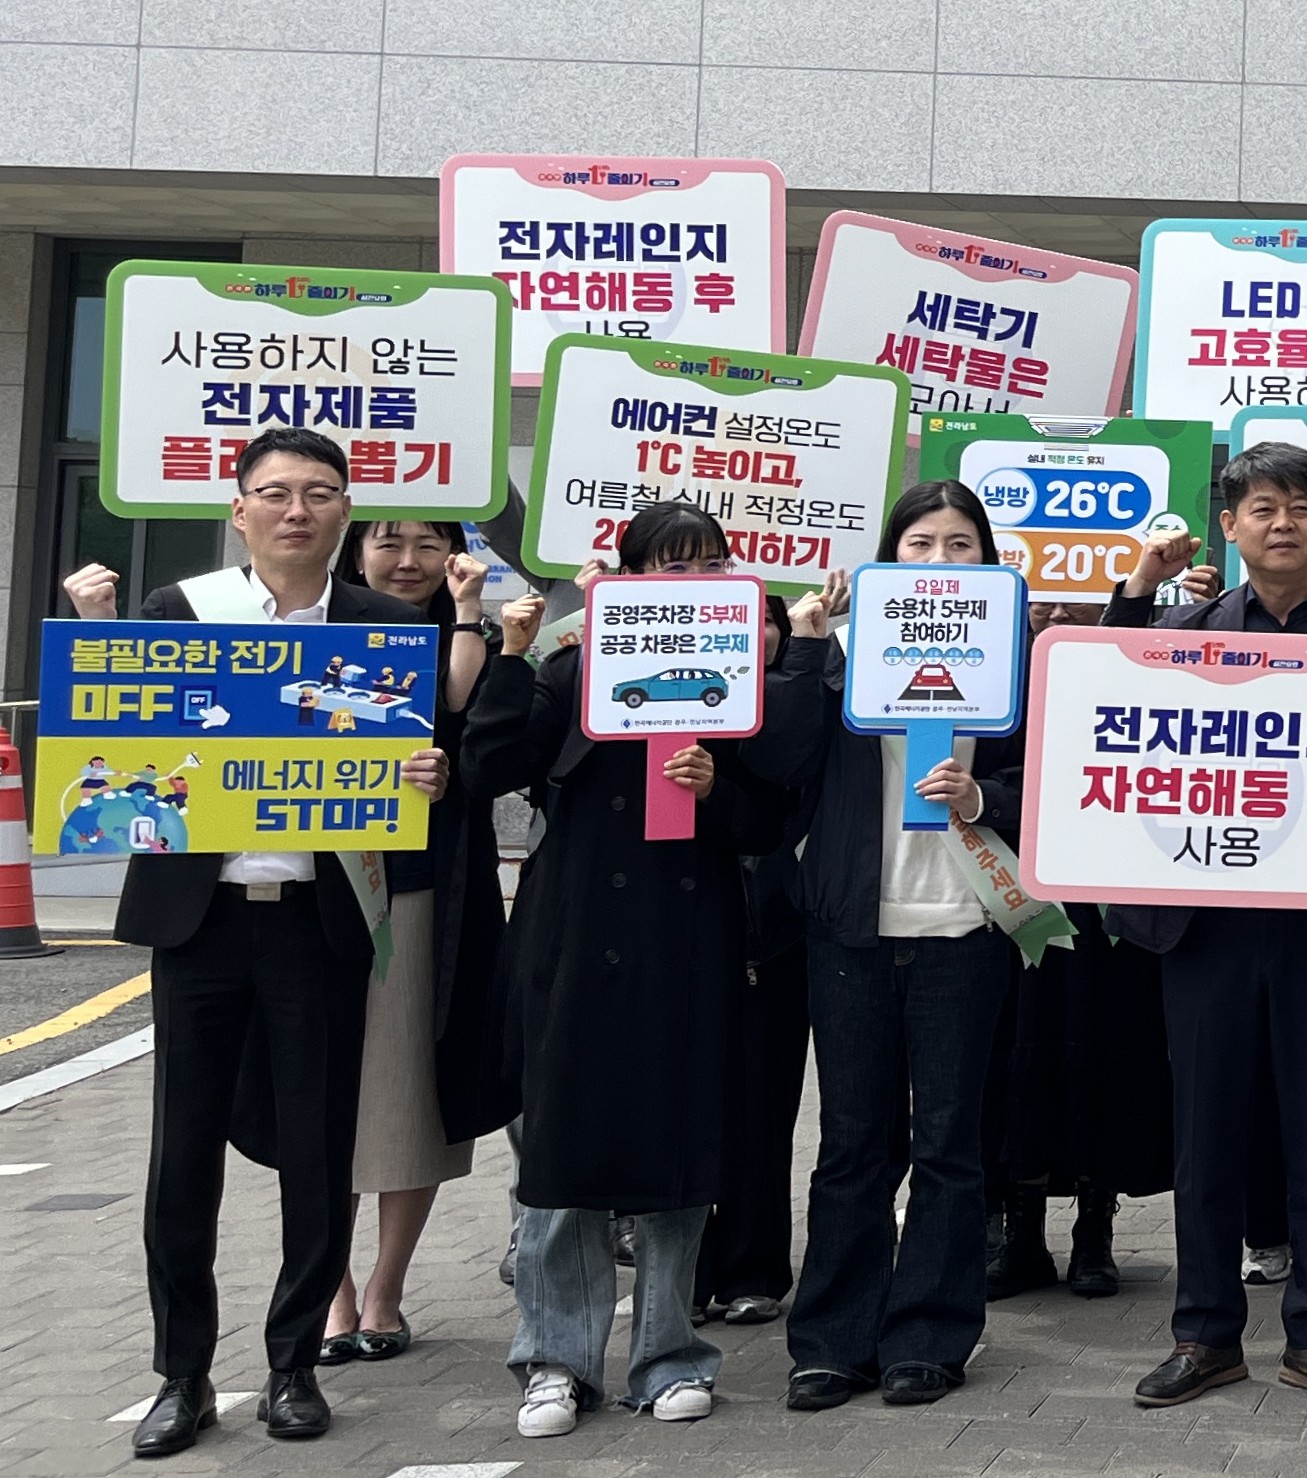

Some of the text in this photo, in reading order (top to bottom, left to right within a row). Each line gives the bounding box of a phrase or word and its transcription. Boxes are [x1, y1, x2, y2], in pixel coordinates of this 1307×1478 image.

[499, 221, 727, 263] 전자레인지
[492, 271, 735, 313] 자연해동 후
[1222, 281, 1300, 318] LED
[907, 290, 1038, 349] 세탁기
[161, 331, 458, 376] 사용하지 않는
[875, 333, 1049, 399] 세탁물은
[202, 382, 417, 429] 전자제품
[611, 398, 841, 449] 에어컨 설정온도
[945, 421, 977, 431] 전라남도
[349, 440, 450, 484] 뽑기
[693, 446, 803, 488] 높이고,
[1028, 454, 1104, 465] 실내 적정 온도 유지
[566, 478, 661, 512] 여름철
[745, 494, 865, 531] 적정온도
[984, 485, 1029, 508] 냉방
[726, 531, 831, 569] 지하기
[997, 550, 1025, 572] 방
[488, 565, 516, 573] BRAN
[914, 579, 960, 595] 요일제
[603, 605, 748, 625] 공영주차장 5부제
[884, 599, 987, 620] 승용차 5부제
[387, 635, 428, 646] 전라남도
[600, 633, 749, 655] 공공 차량은 2부제
[900, 622, 968, 643] 참여하기
[70, 638, 302, 675] 불필요한 전기
[71, 684, 175, 721] OFF
[222, 759, 401, 791] 에너지 위기
[1080, 766, 1289, 819] 자연해동
[255, 798, 400, 833] STOP!
[950, 808, 1028, 911] 해주세요
[1173, 826, 1261, 867] 사용
